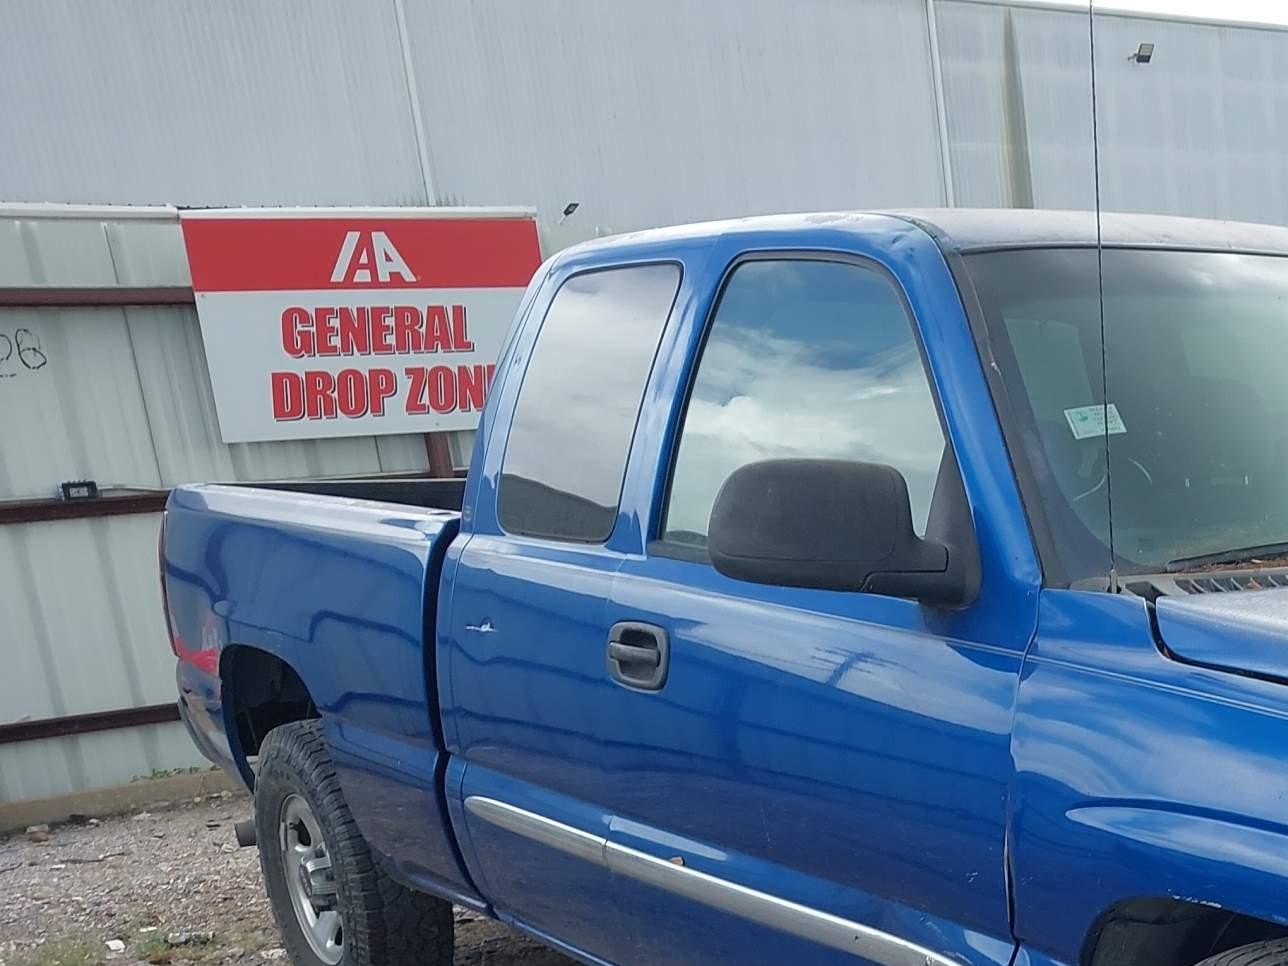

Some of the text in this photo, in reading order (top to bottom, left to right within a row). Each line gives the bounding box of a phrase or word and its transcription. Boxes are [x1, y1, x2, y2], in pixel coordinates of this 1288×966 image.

[280, 304, 475, 359] GENERAL
[271, 364, 497, 422] DROP ZON
